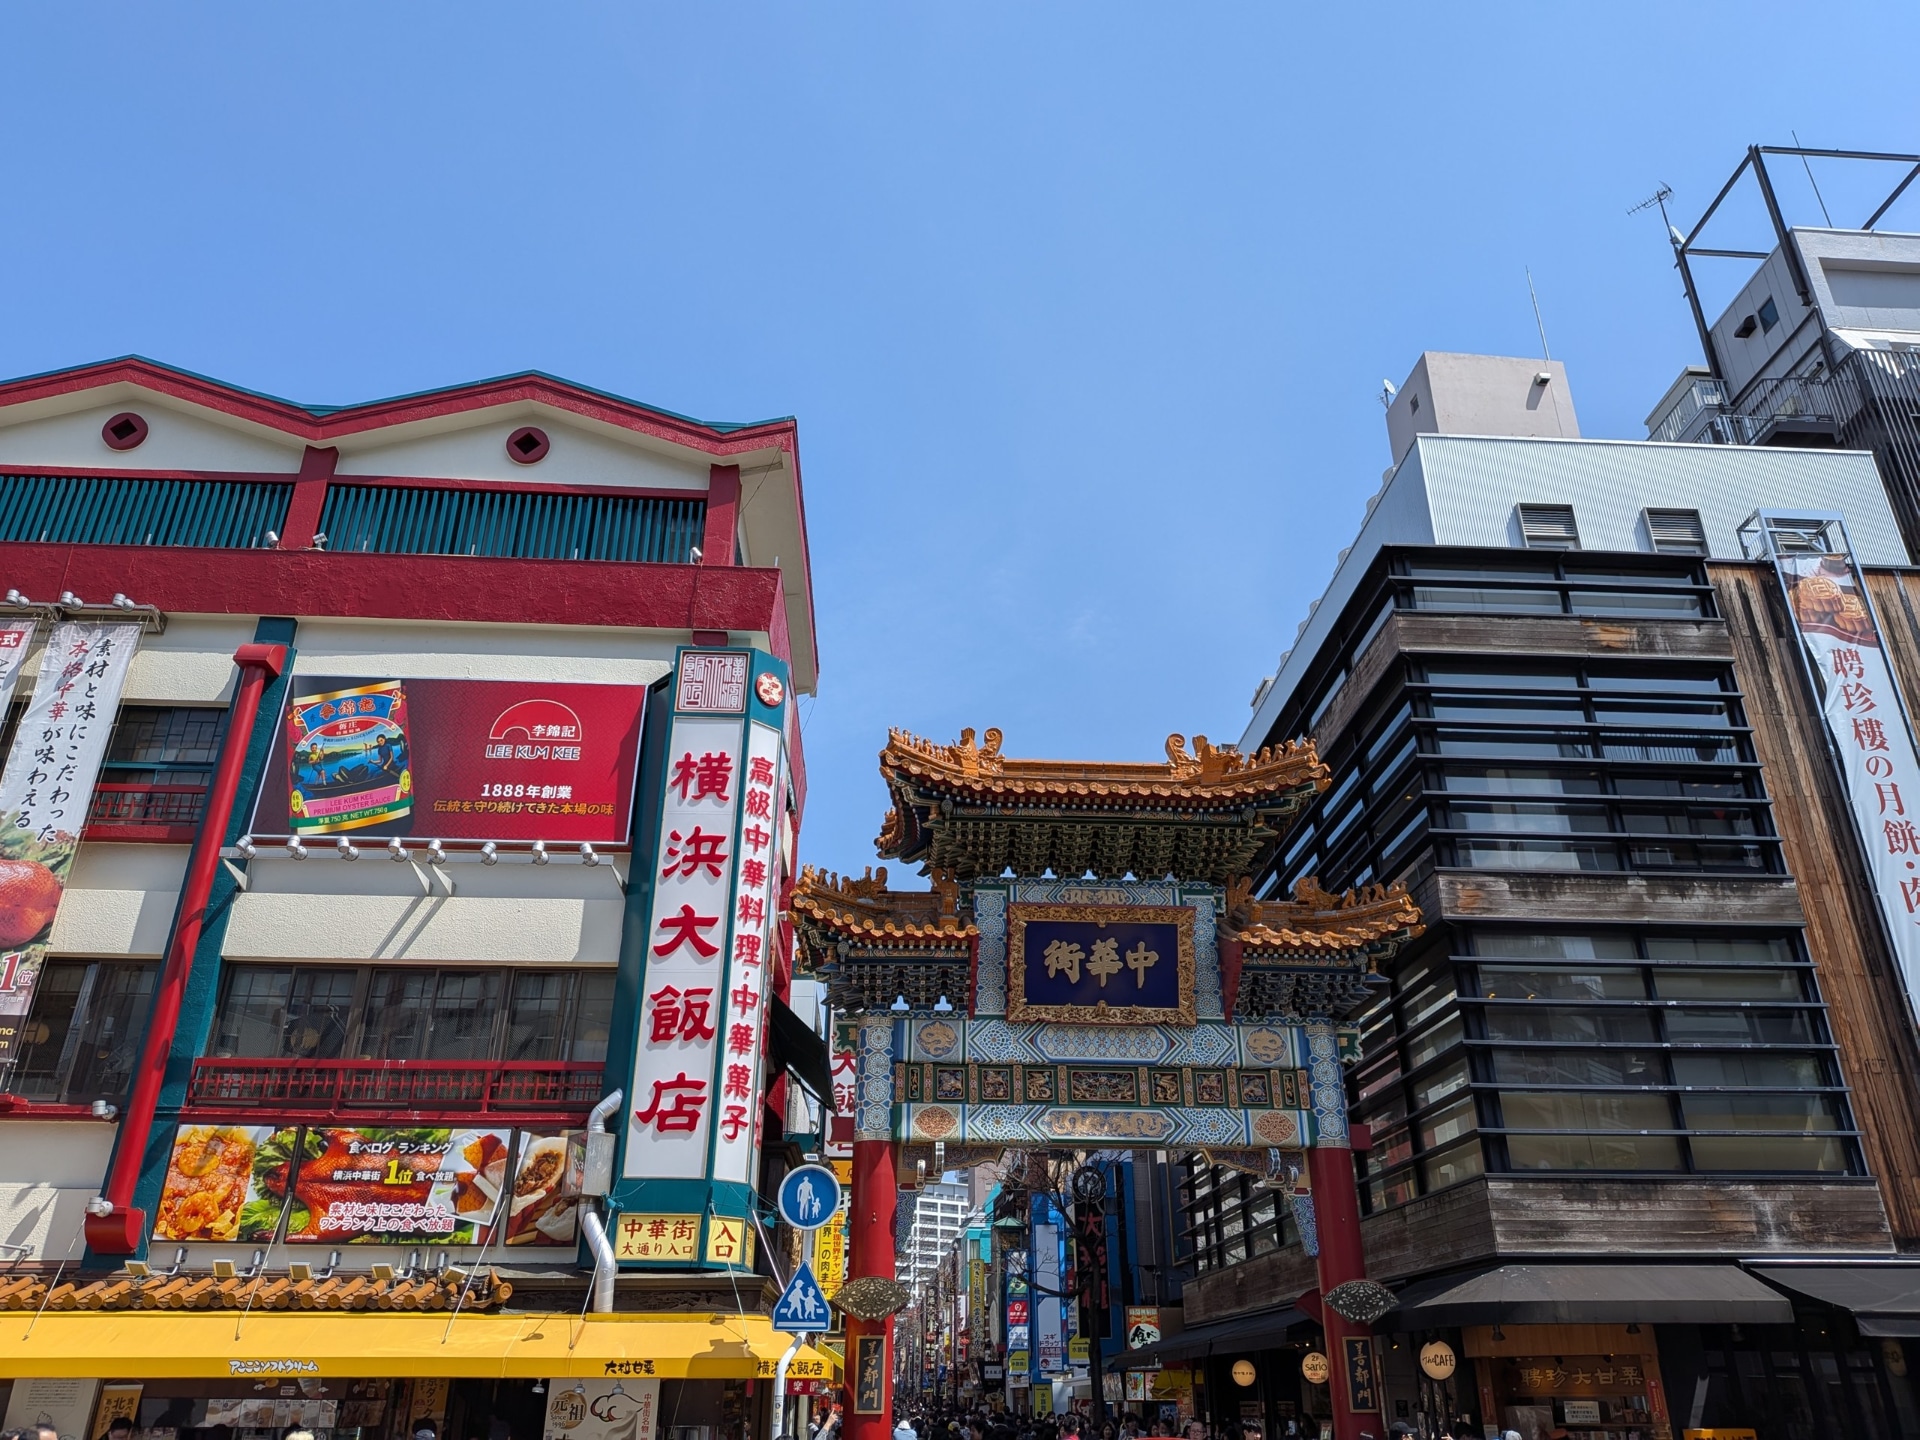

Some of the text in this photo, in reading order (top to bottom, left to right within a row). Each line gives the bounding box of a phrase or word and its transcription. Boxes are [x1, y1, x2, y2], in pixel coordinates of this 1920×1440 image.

[15, 640, 89, 828] 本格中華が味わえる
[531, 725, 576, 738] 李錦記
[37, 639, 117, 842] 素材と味にこだわった
[486, 745, 580, 760] LEE KUM KEE
[481, 783, 572, 799] 1888年創業
[314, 795, 391, 815] PREMIUM OYSTER SAUCE
[344, 796, 359, 804] KUM
[433, 799, 615, 816] 伝統を守り続けてきた本場の味
[350, 811, 363, 819] NET
[635, 752, 733, 1132] 横浜大飯店
[721, 756, 774, 1141] 高級中華料理・中華菓子
[349, 1141, 453, 1155] 食べログ ランキング
[333, 1159, 455, 1184] 横浜中華街 1位 食べ放題
[329, 1202, 447, 1218] 素材と味にこだわった
[319, 1217, 456, 1232] ワンランク上の食べ放題
[624, 1219, 696, 1240] 中華街
[714, 1222, 737, 1258] 入口
[621, 1242, 693, 1256] 大通り入口
[819, 1221, 832, 1295] 界一の肉まん
[604, 1360, 655, 1376] 大粒甘栗
[1305, 1361, 1327, 1371] sario
[1434, 1354, 1454, 1366] CAFE
[1520, 1366, 1644, 1388] 聘珍大甘栗
[551, 1394, 585, 1421] 元祖
[641, 1393, 652, 1434] 中華街名物
